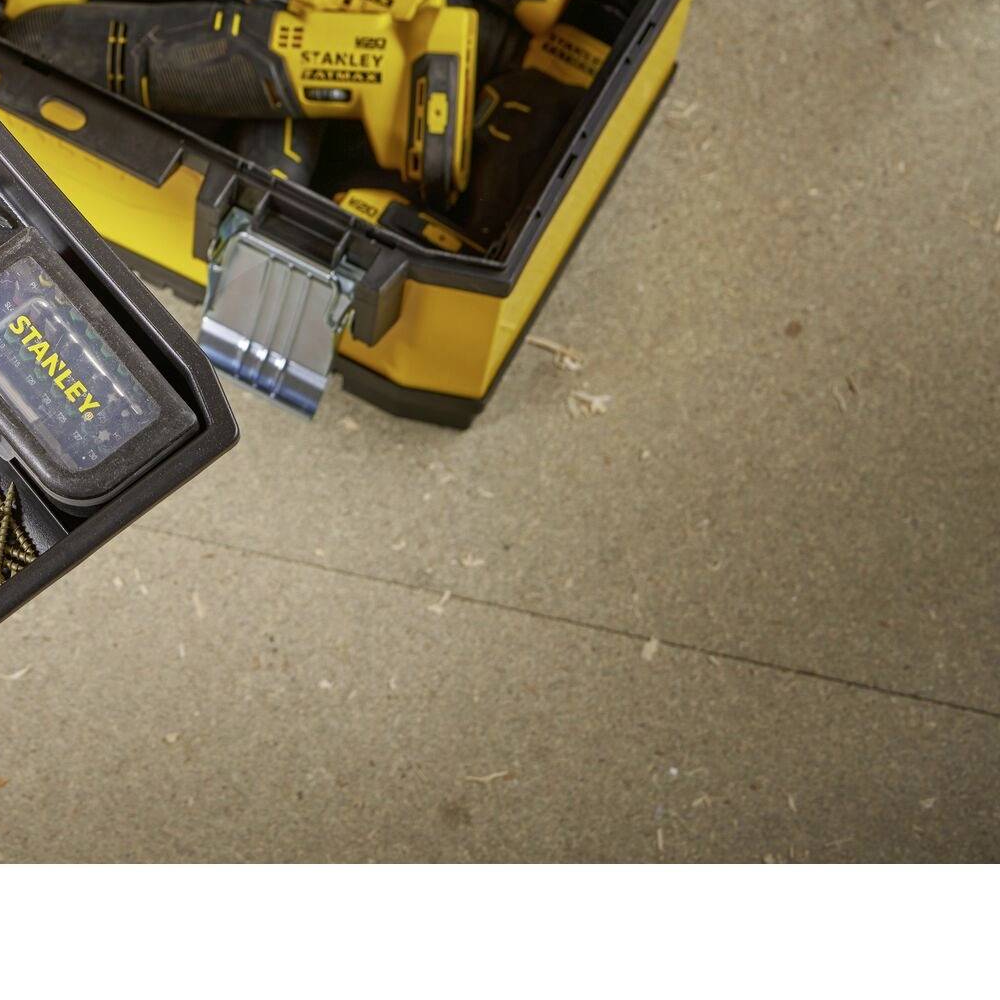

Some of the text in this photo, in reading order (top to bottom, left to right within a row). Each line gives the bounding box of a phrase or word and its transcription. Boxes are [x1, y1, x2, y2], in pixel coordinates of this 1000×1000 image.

[300, 50, 383, 68] STANLEY
[301, 69, 382, 84] FATMAX
[9, 315, 101, 414] STANLEY
